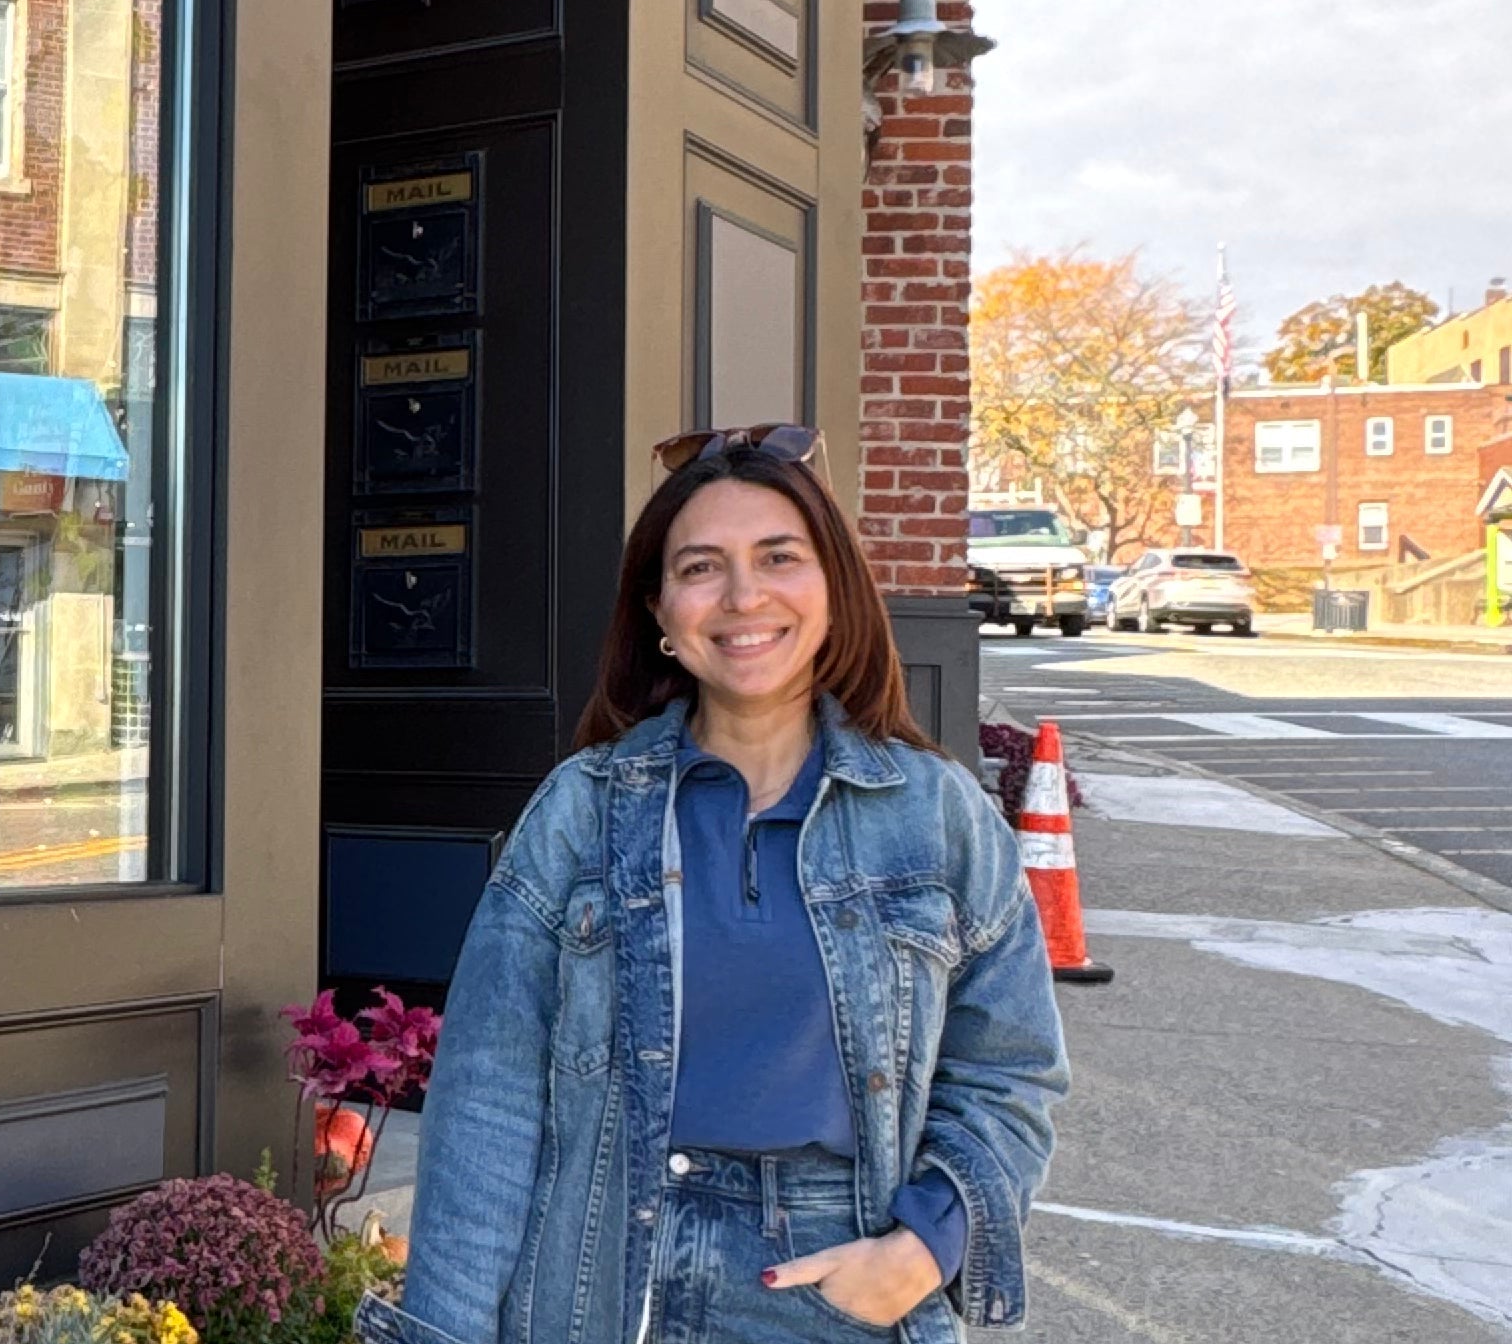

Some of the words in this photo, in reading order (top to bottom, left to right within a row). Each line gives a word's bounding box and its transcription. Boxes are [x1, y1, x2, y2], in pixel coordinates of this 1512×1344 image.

[386, 181, 452, 204] MAIL
[383, 358, 450, 377] MAIL
[380, 533, 447, 550] MAIL
